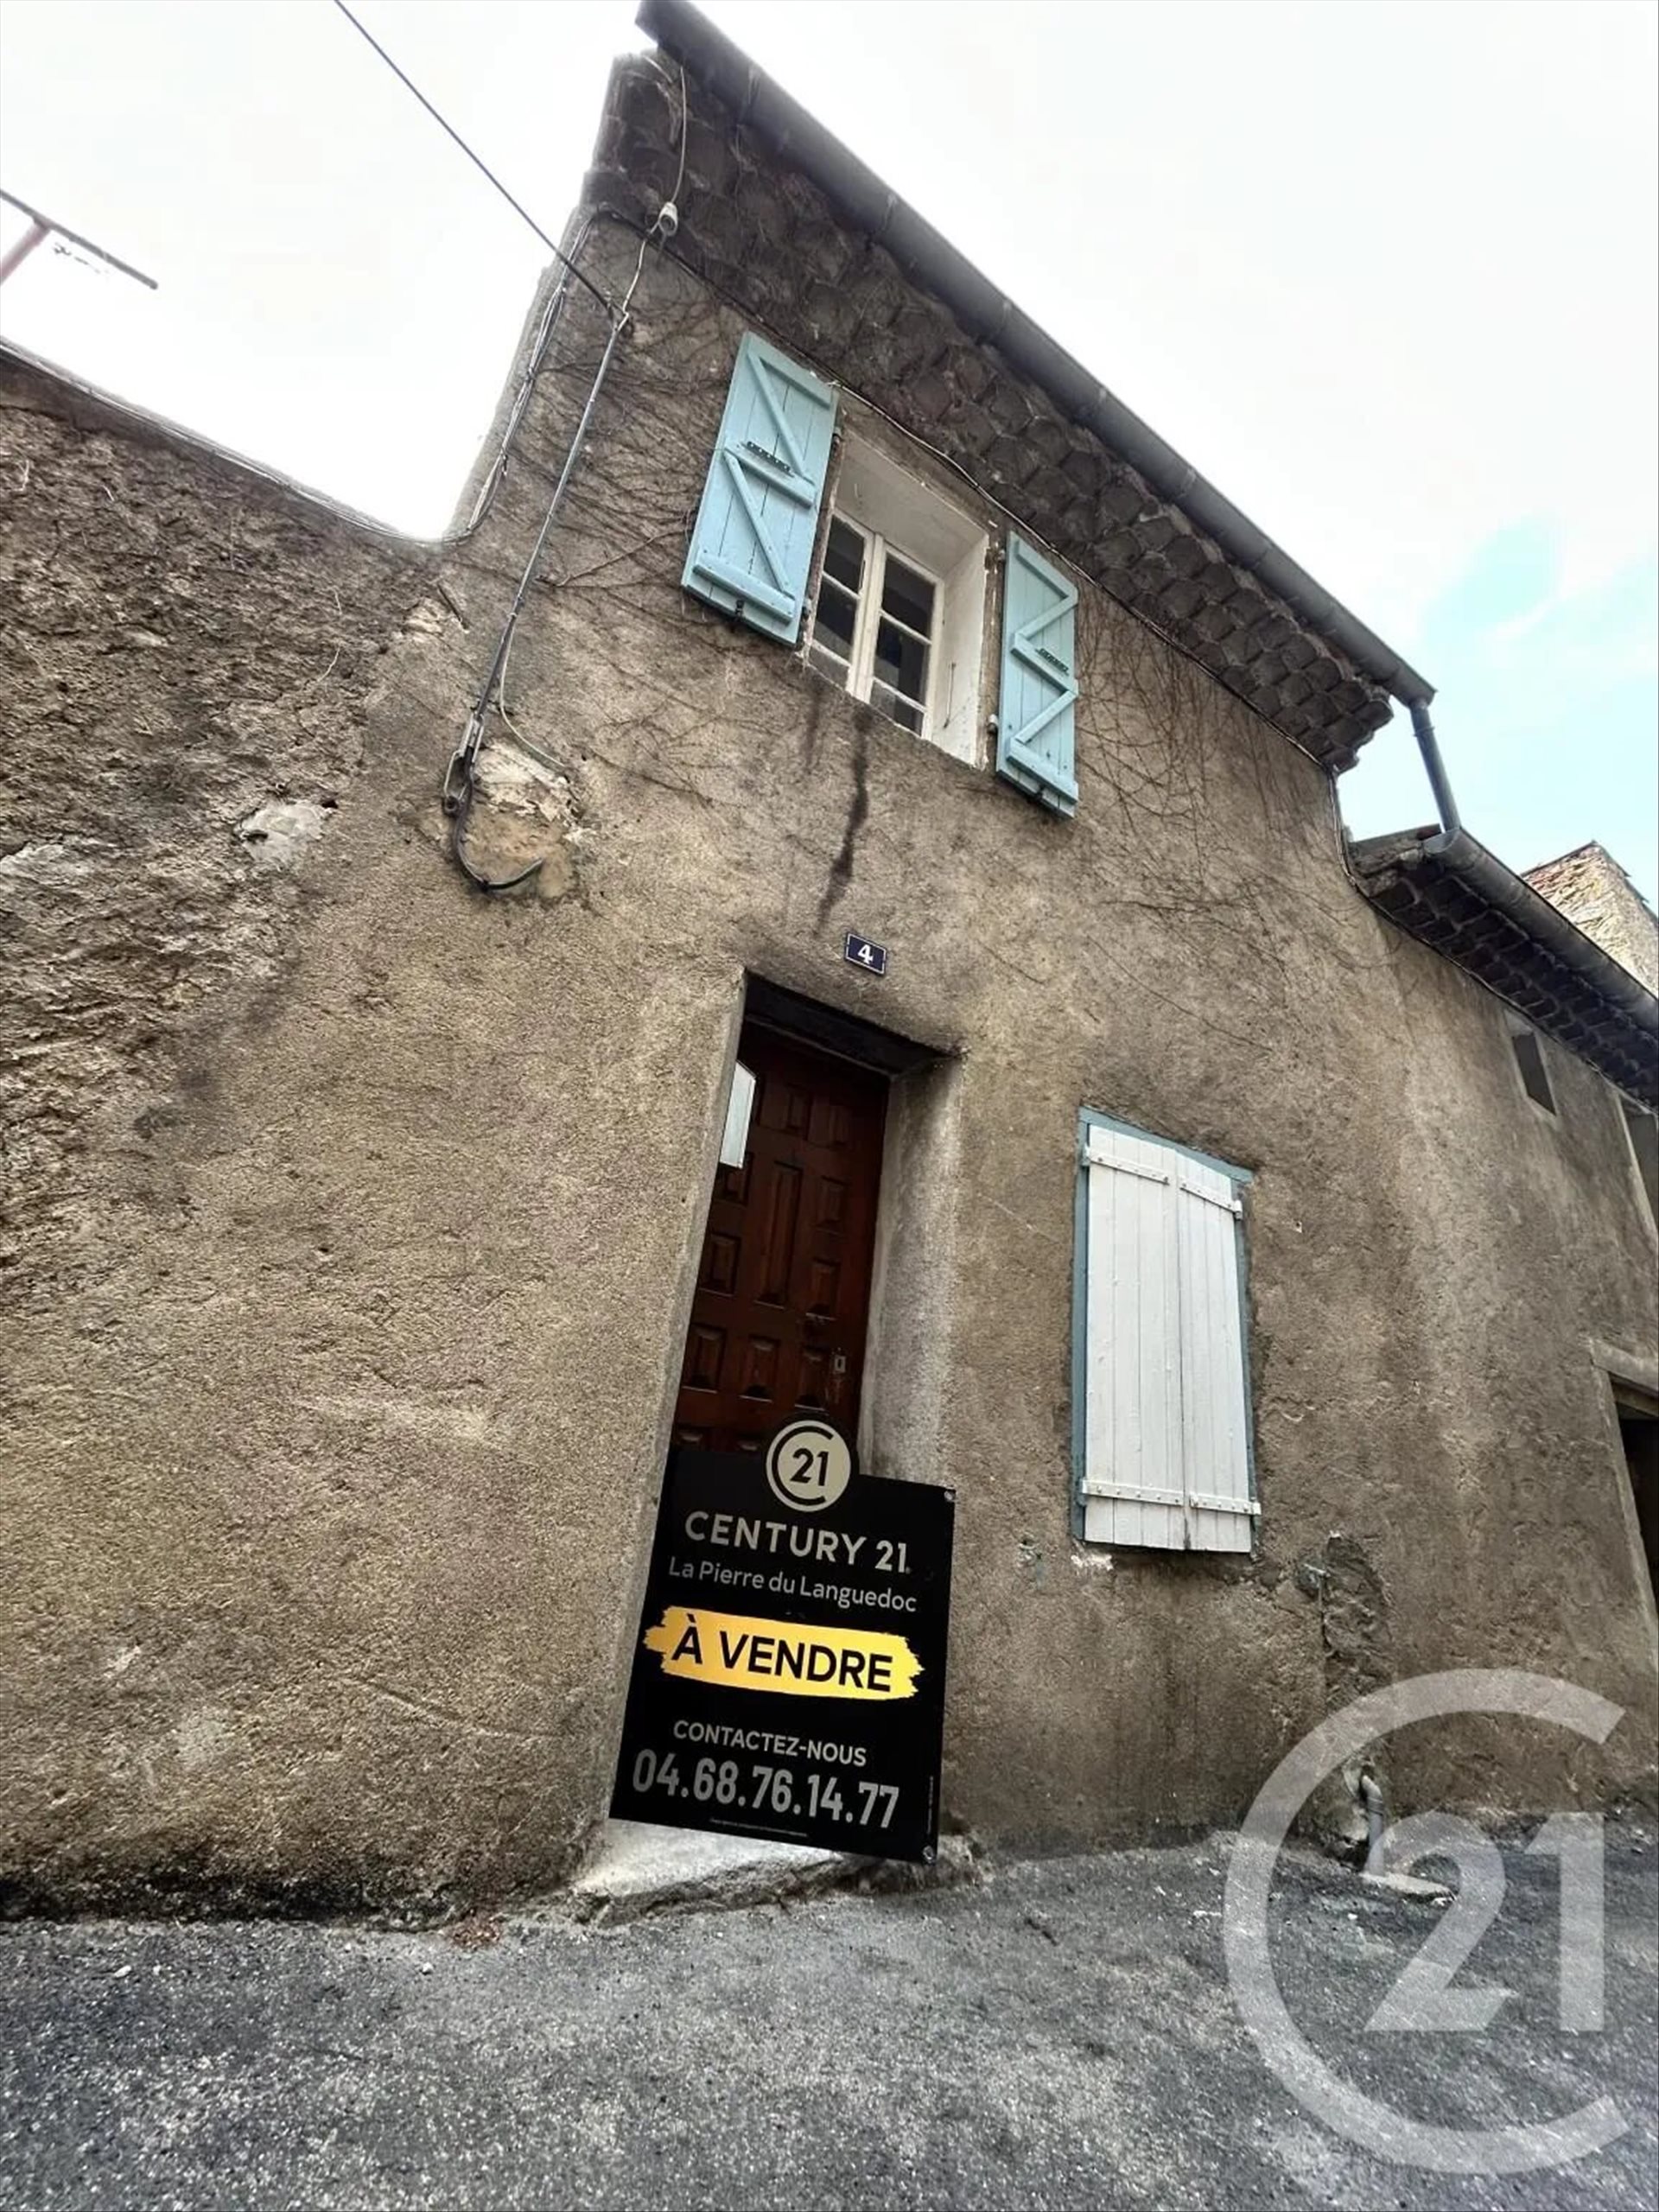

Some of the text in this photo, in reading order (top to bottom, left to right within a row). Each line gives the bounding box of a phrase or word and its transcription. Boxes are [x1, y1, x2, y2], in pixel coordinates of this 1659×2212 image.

[857, 944, 874, 964] 4
[685, 1511, 867, 1566] CENTURY
[669, 1556, 917, 1612] La Pierre du Languedoc
[671, 1613, 893, 1693] À VENDRE
[673, 1720, 868, 1767] CONTACTEZ-NOUS
[632, 1748, 900, 1829] 04.68.76.14.77
